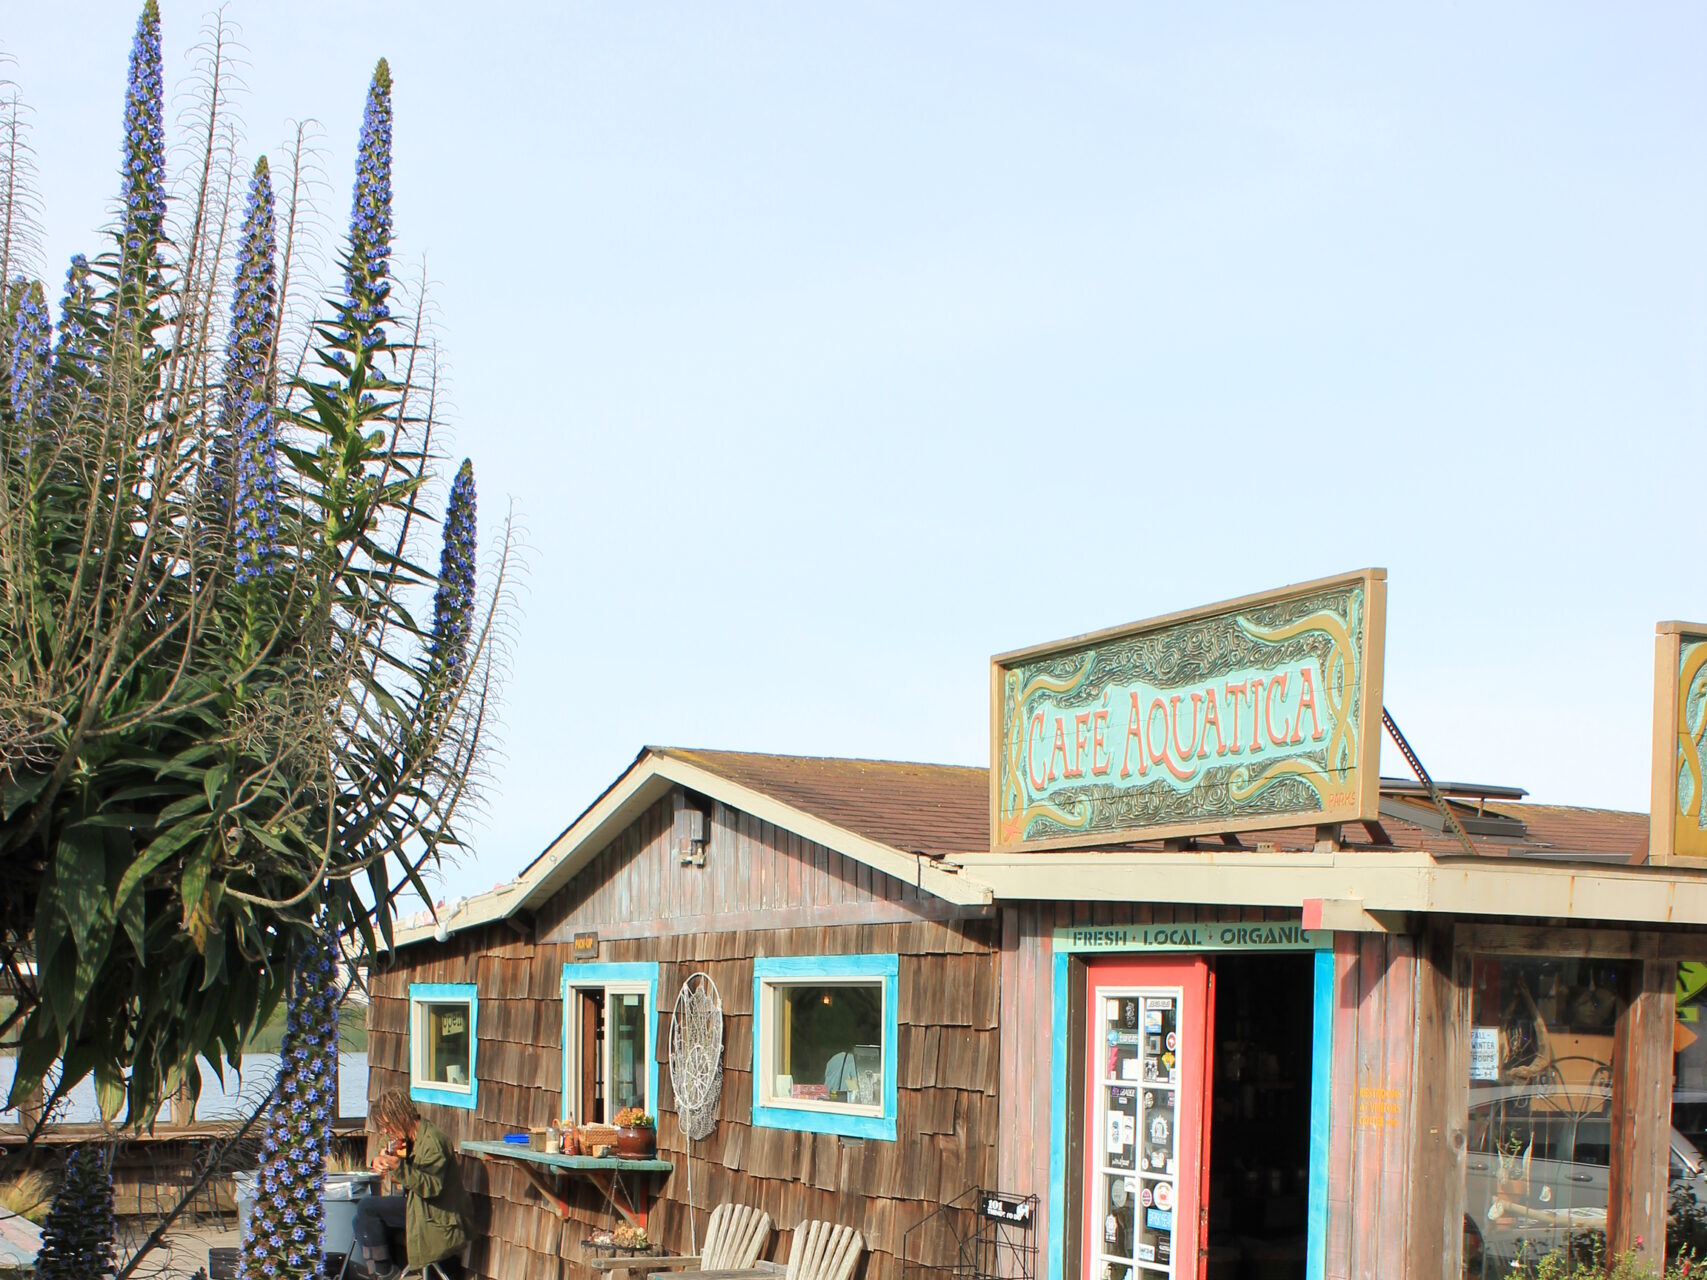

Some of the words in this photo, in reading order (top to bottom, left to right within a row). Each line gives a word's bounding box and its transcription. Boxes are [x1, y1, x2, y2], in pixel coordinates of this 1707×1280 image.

[1027, 685, 1112, 790] CAFÉ
[1121, 668, 1324, 780] AQUATICA
[1073, 930, 1127, 946] FRESH
[1143, 928, 1202, 945] LOCAL
[1220, 926, 1309, 945] ORGANIC
[442, 1013, 462, 1033] open
[988, 1200, 1003, 1211] 101
